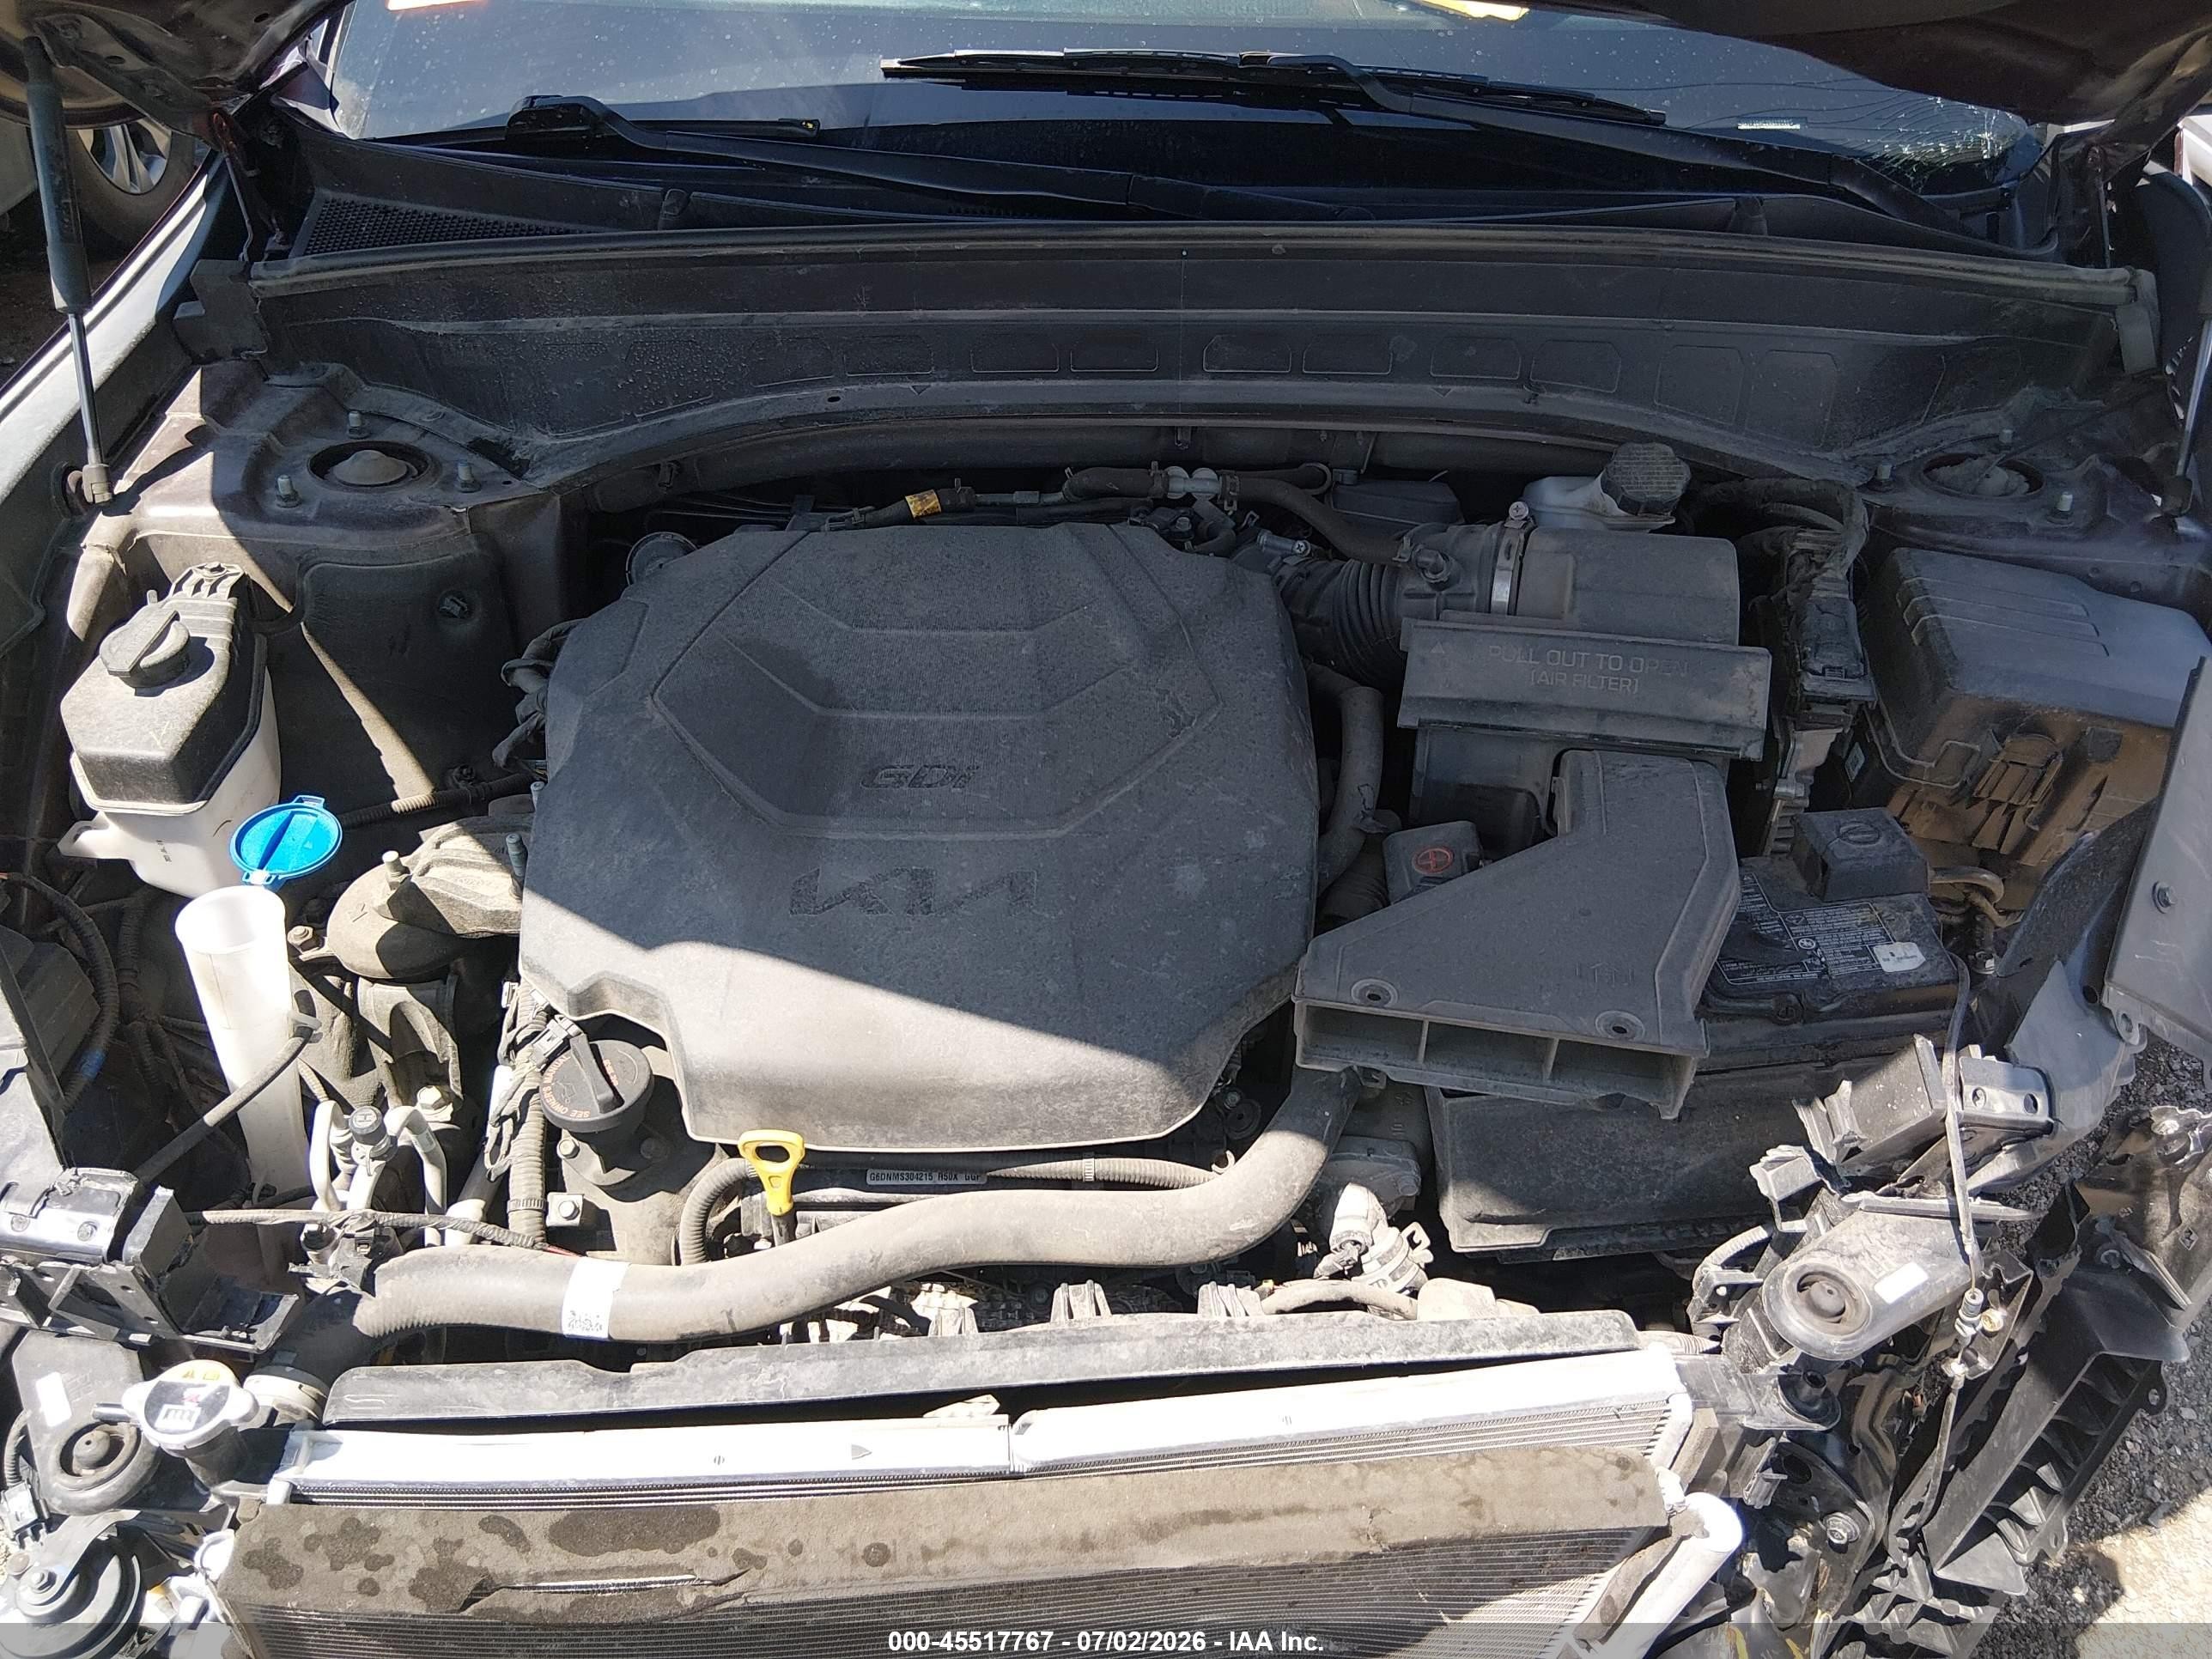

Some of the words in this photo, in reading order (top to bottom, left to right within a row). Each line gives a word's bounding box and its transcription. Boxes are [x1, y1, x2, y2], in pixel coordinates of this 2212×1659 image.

[1489, 645, 1540, 665] PULL
[1547, 650, 1590, 669] OUT
[1595, 653, 1623, 672] TO
[1630, 657, 1689, 678] OPEN
[543, 1054, 572, 1084] MANUAL
[569, 1109, 591, 1118] SEE
